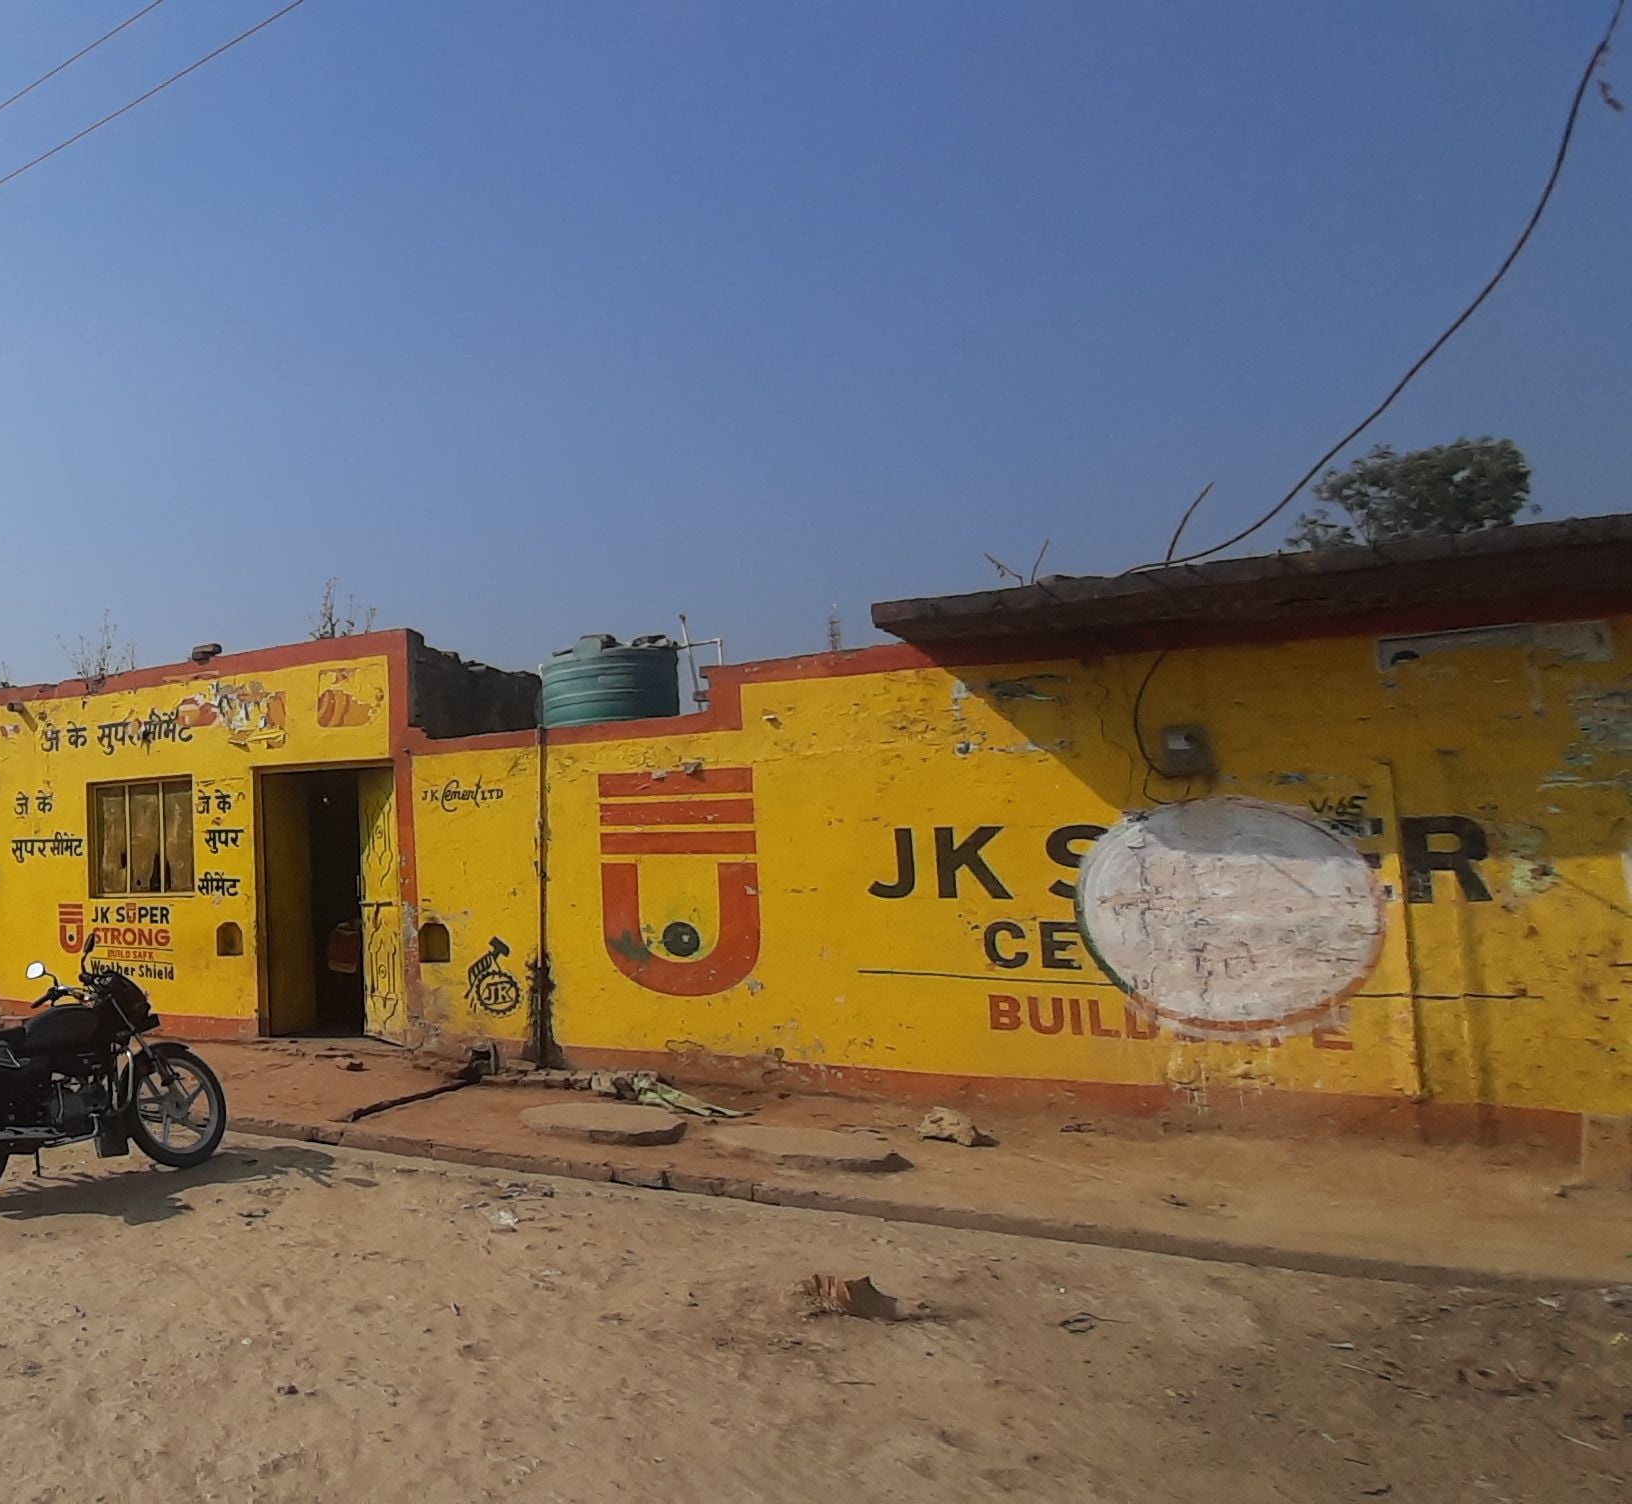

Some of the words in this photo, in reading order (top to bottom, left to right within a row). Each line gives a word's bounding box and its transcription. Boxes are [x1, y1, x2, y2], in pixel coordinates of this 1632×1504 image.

[67, 719, 87, 749] के
[14, 791, 29, 815] जे
[35, 789, 53, 814] के
[196, 789, 211, 814] जे
[214, 789, 231, 813] के
[441, 774, 482, 812] Cement
[481, 788, 504, 801] LTD
[205, 829, 244, 854] सुपर
[867, 823, 1014, 902] JK
[198, 871, 240, 896] सीमेंट
[91, 906, 111, 923] JK
[93, 927, 171, 947] STRONG
[138, 963, 174, 981] Shield
